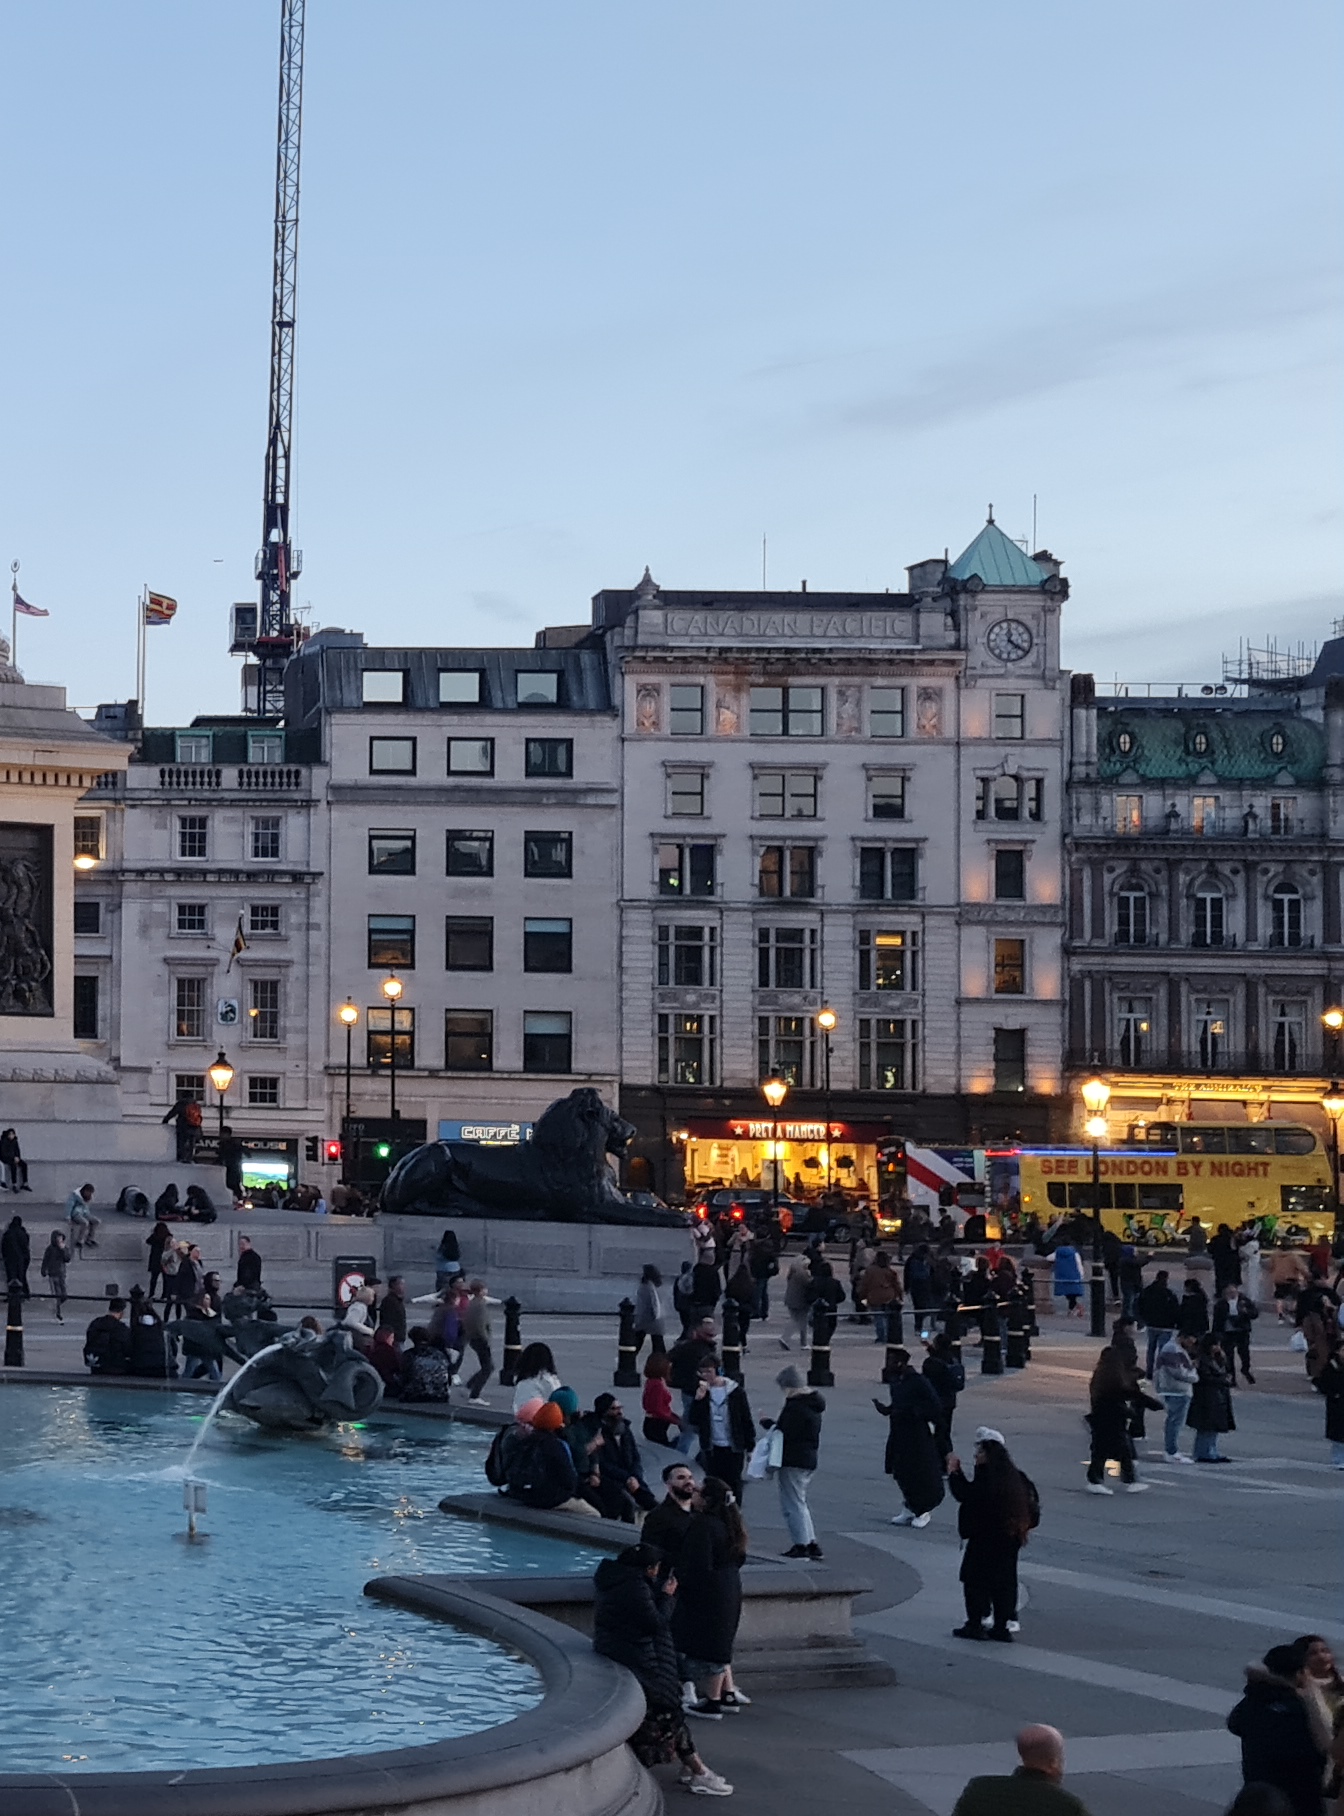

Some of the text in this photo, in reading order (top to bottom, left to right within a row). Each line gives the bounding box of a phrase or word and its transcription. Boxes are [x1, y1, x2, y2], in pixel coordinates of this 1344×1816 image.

[670, 612, 907, 638] CANADIAN PACIFIC
[748, 1123, 827, 1140] PRET A MANGER
[1040, 1159, 1078, 1175] SEE
[1084, 1160, 1169, 1177] LONDON
[1175, 1161, 1204, 1177] BY
[1209, 1161, 1272, 1179] NIGHT
